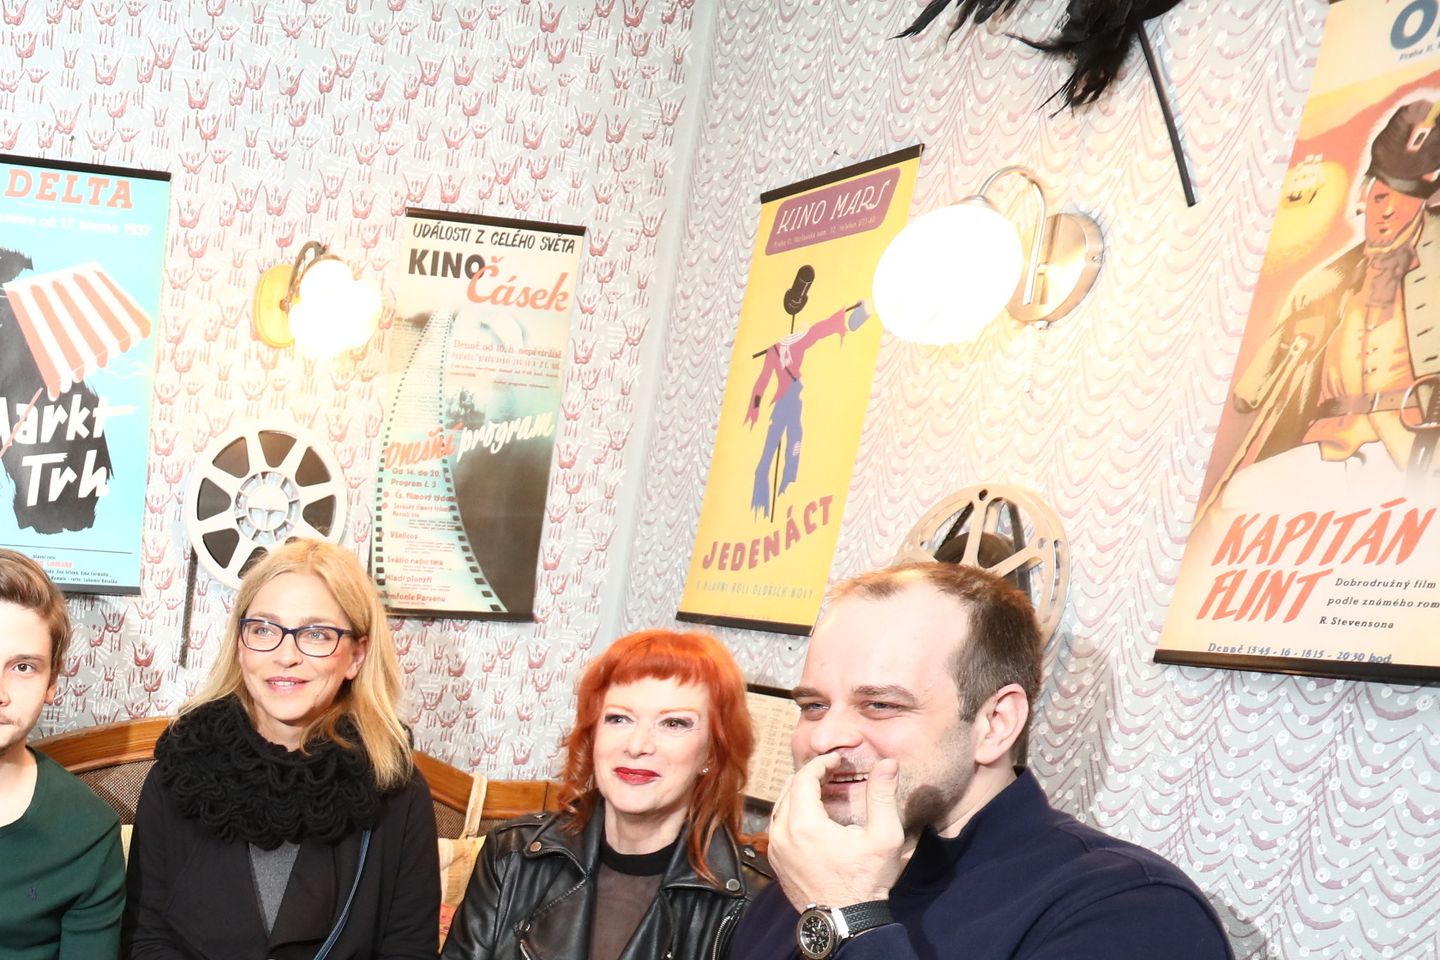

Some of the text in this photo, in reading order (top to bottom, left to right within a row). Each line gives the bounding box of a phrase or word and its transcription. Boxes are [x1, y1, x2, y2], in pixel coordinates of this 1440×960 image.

[1390, 0, 1440, 50] O
[5, 168, 133, 209] DELTA
[777, 180, 891, 235] KINO MARS
[412, 221, 576, 254] UDÁLOSTI Z CELÉHO SVĚTA
[408, 249, 570, 313] KINO Čásek
[455, 411, 555, 463] program
[21, 449, 110, 507] Trh
[391, 478, 423, 488] Program
[392, 467, 404, 475] Od
[702, 495, 833, 572] JEDENÁCT
[1211, 497, 1436, 566] KAPITÁN
[1196, 568, 1334, 624] FLINT
[1326, 597, 1440, 609] podle známého rom
[1335, 578, 1436, 591] Dobrodružný film
[1319, 616, 1394, 629] R. Stevensona
